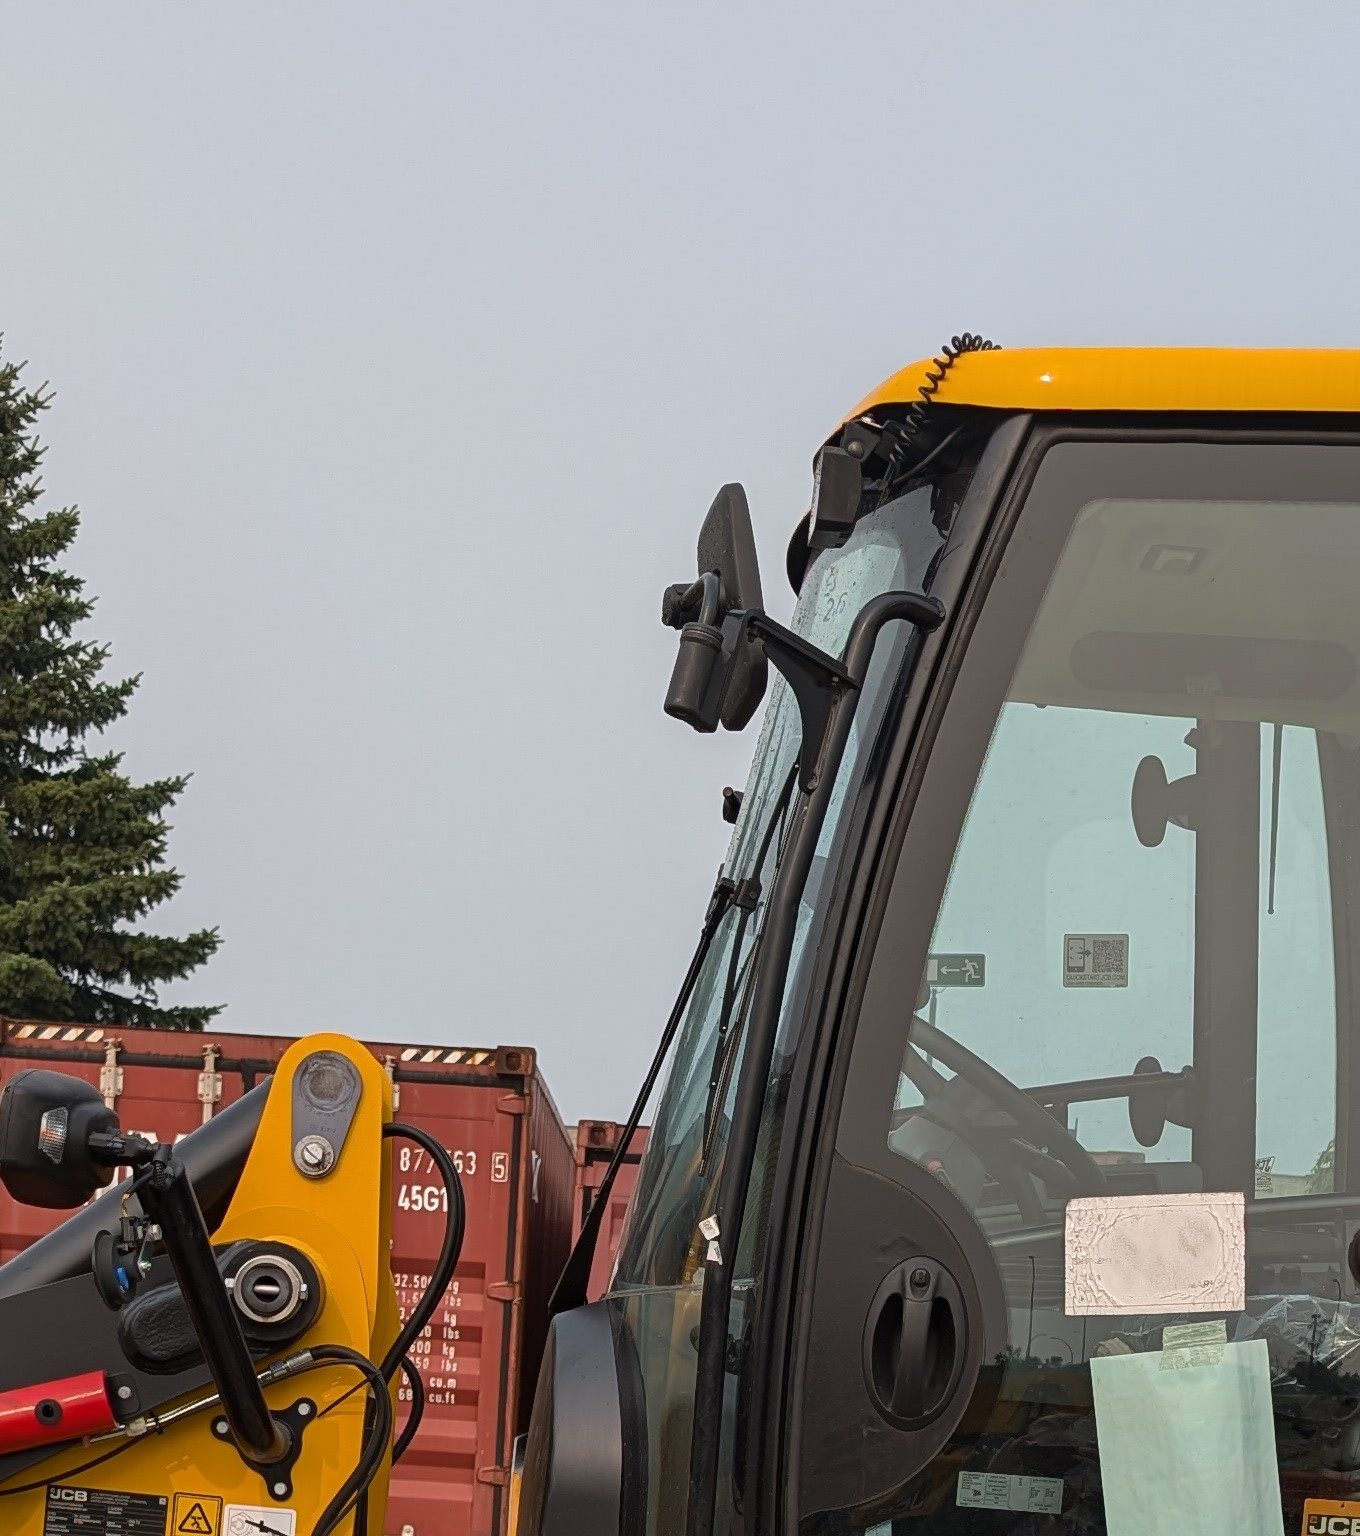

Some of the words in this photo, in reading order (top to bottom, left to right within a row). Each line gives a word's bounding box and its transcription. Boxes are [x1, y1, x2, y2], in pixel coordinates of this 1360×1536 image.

[493, 1155, 505, 1179] 5
[398, 1185, 448, 1212] 45G1
[444, 1295, 461, 1307] lbs
[443, 1310, 456, 1327] kg
[443, 1327, 460, 1340] lbs
[442, 1342, 455, 1359] kg
[441, 1358, 458, 1372] lbs
[429, 1375, 456, 1388] cu.m
[428, 1391, 455, 1405] cu.ft
[50, 1488, 88, 1502] JCB
